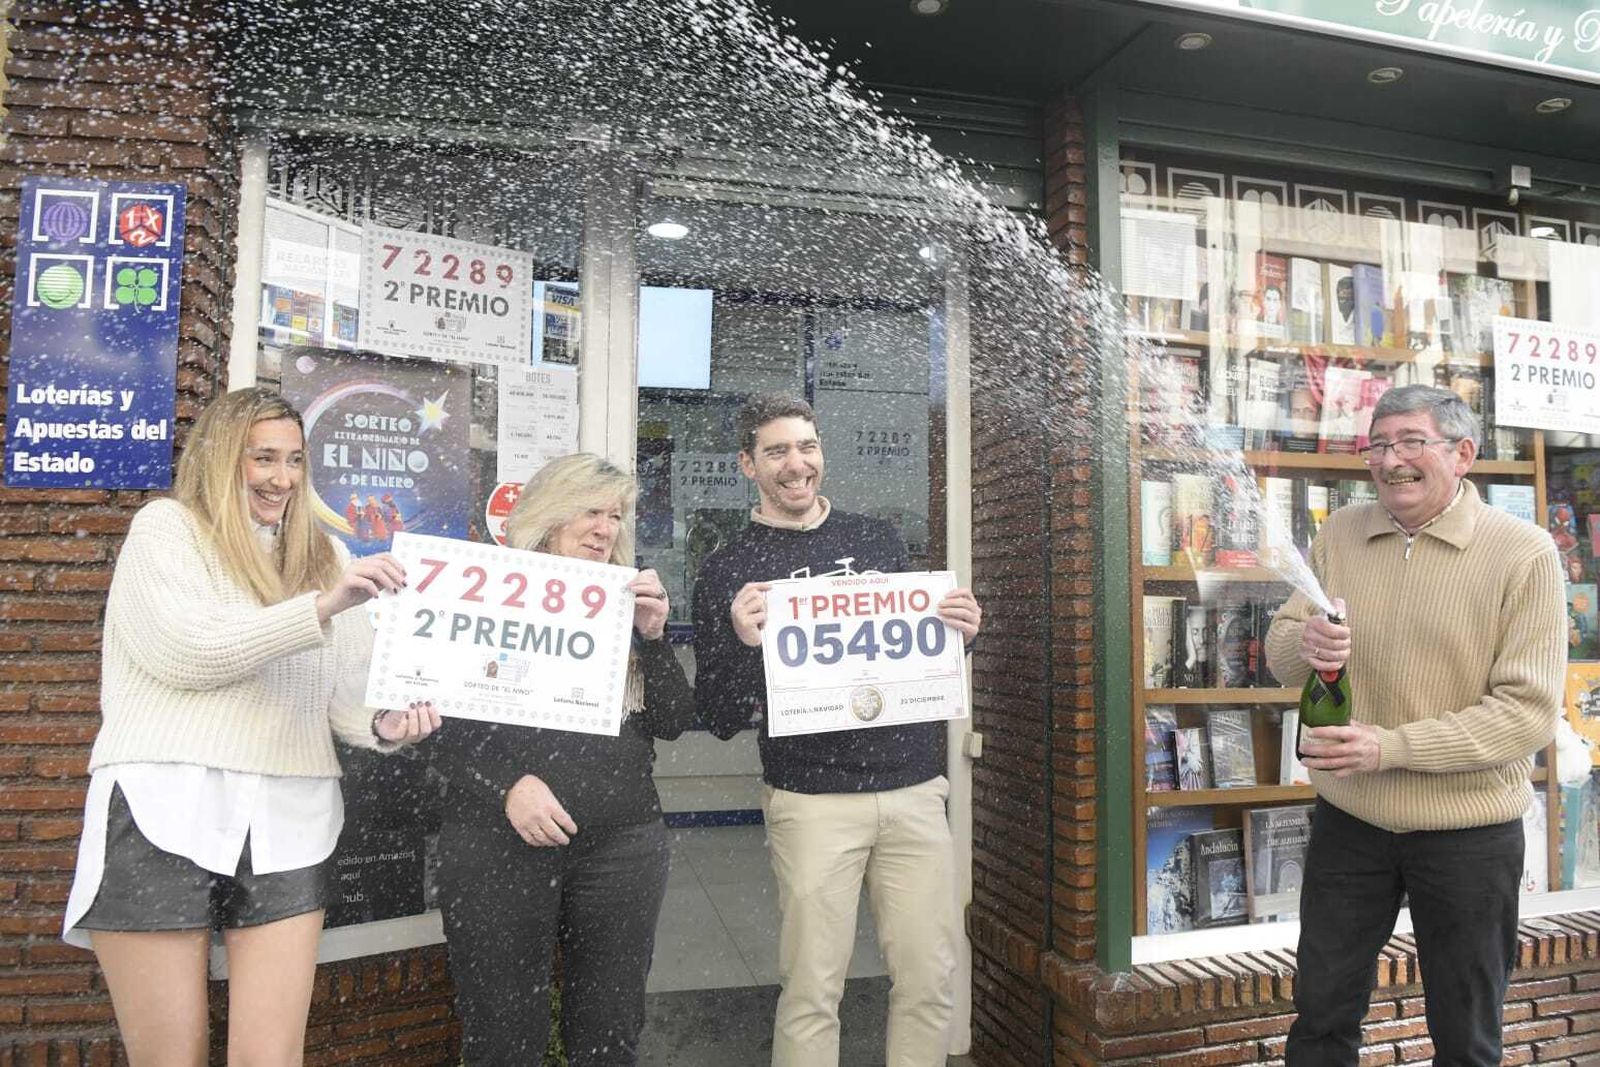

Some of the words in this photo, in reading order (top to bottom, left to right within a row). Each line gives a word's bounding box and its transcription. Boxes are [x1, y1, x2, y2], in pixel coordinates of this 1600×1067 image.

[1534, 23, 1565, 64] y
[381, 243, 515, 288] 72289
[409, 284, 510, 317] PREMIO
[1507, 332, 1597, 364] 72289
[1528, 365, 1596, 390] PREMIO
[17, 383, 113, 405] Loterías
[120, 388, 135, 411] y
[14, 417, 124, 444] Apuestas
[131, 418, 167, 441] del
[344, 413, 412, 433] SORTEO
[13, 451, 95, 474] Estado
[323, 443, 353, 468] EL
[361, 445, 430, 474] NIÑO
[339, 473, 348, 485] 6
[351, 474, 368, 486] DE
[371, 475, 415, 489] ENERO
[691, 476, 738, 488] PREMIO
[415, 558, 607, 619] 72289
[831, 578, 867, 587] VENDIDO
[811, 589, 931, 619] PREMIO
[450, 613, 595, 660] PREMIO
[776, 616, 946, 668] 05490
[909, 695, 945, 704] DICIEMBRE
